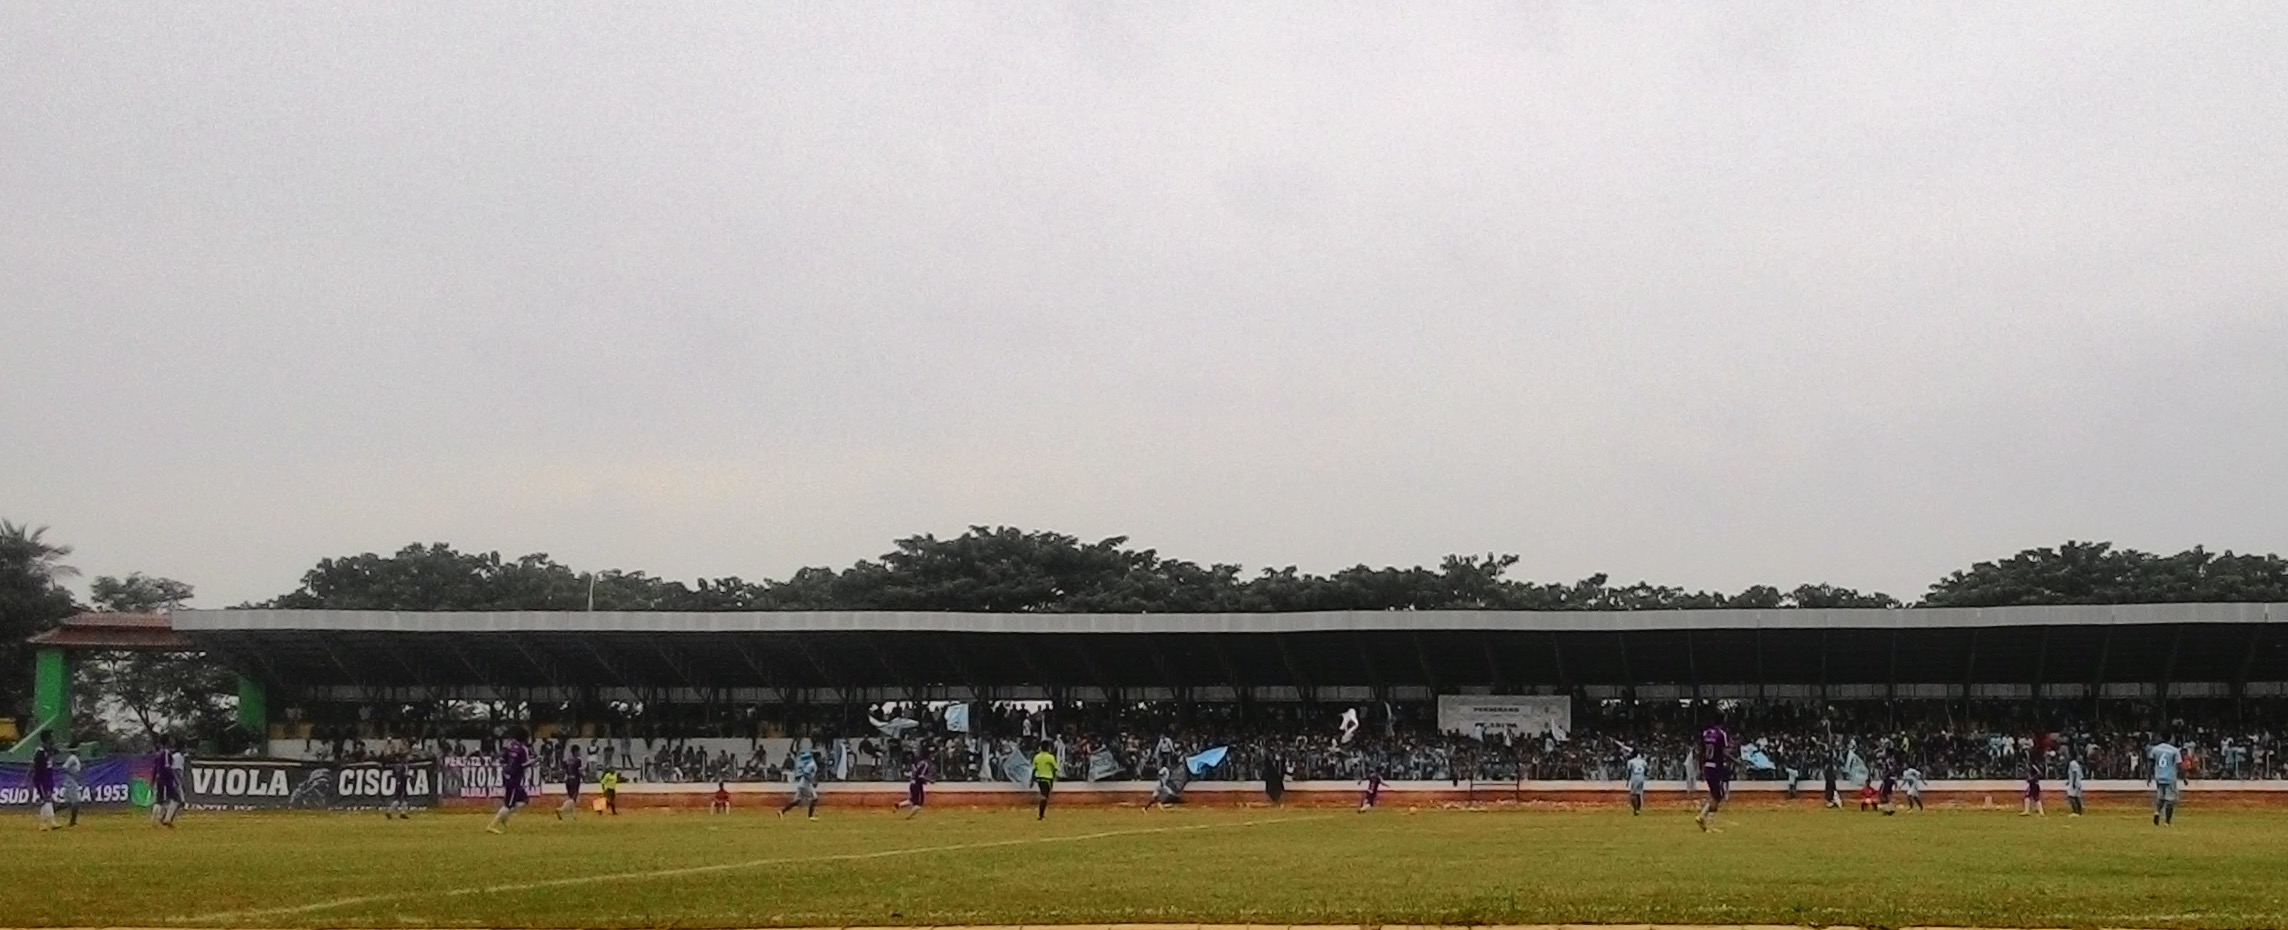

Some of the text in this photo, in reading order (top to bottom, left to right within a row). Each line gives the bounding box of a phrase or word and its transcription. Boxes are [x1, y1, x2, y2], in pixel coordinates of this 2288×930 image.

[2159, 753, 2168, 767] 6
[191, 768, 289, 795] VIOLA
[461, 766, 504, 788] VIOLA
[0, 787, 29, 804] SUD
[95, 784, 129, 802] 1953
